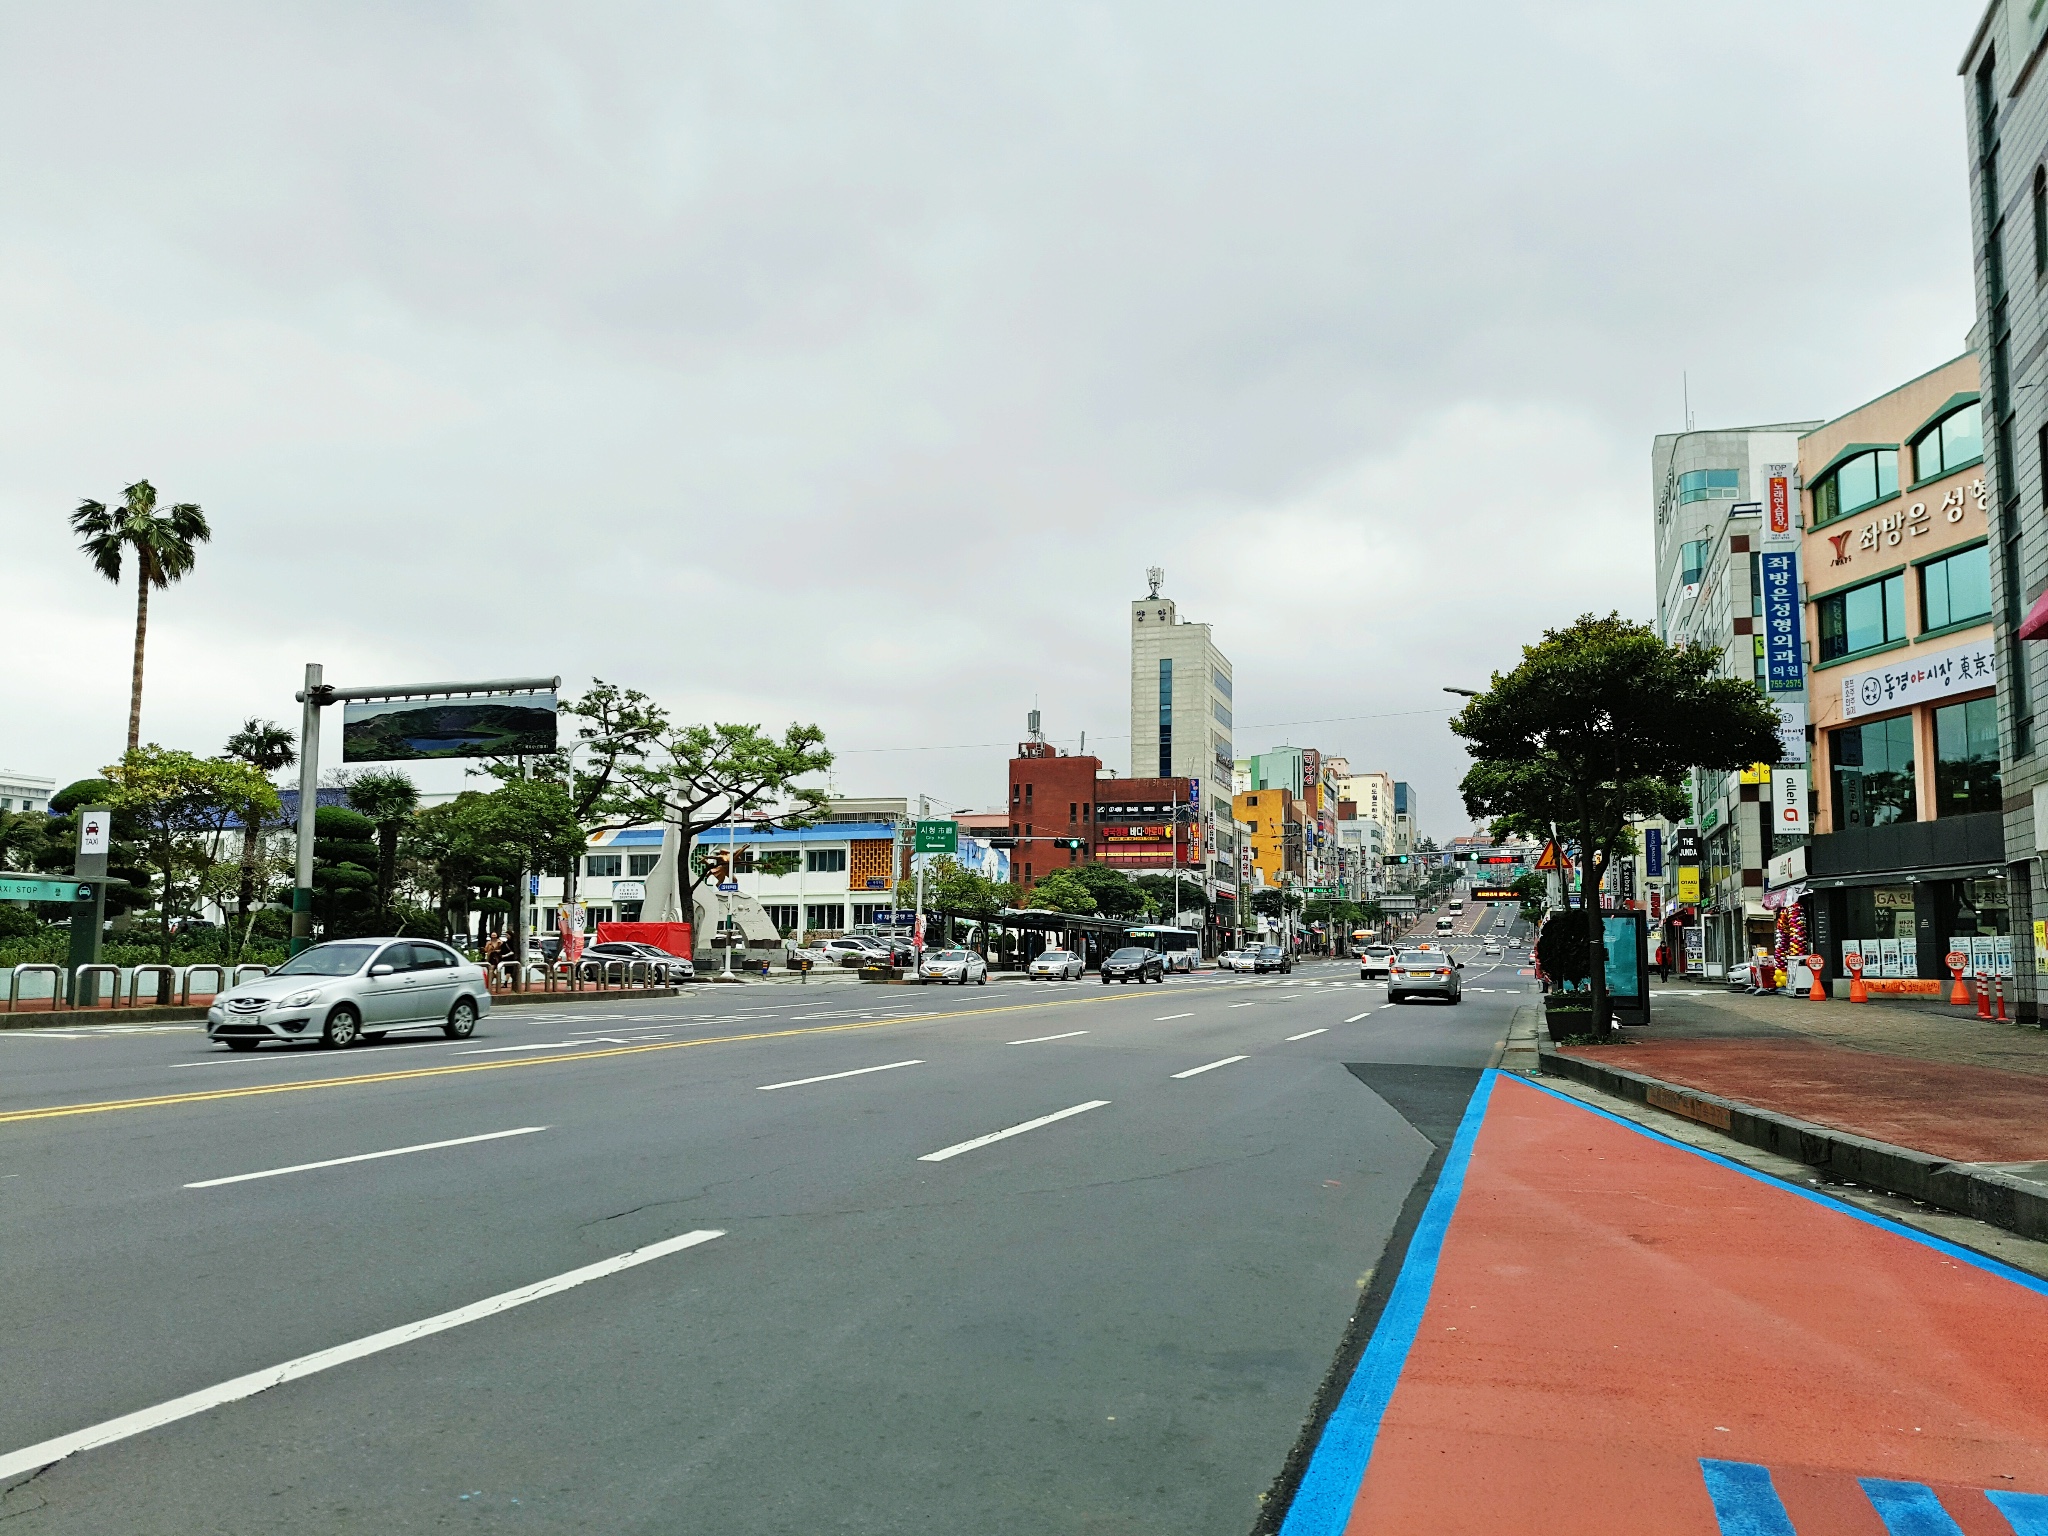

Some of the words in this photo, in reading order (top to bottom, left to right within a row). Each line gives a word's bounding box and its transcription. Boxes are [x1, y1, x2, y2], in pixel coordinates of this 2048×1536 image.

[1773, 482, 1785, 526] 노래연습장
[1858, 502, 1931, 552] 좌방은
[1767, 556, 1796, 664] 좌방은성형외과
[1772, 665, 1799, 677] 의원
[1770, 679, 1802, 689] 755-2575
[1884, 657, 1954, 700] 동경야시장
[920, 826, 936, 834] 시청
[1683, 838, 1694, 846] THE
[1680, 848, 1698, 857] JUNDA
